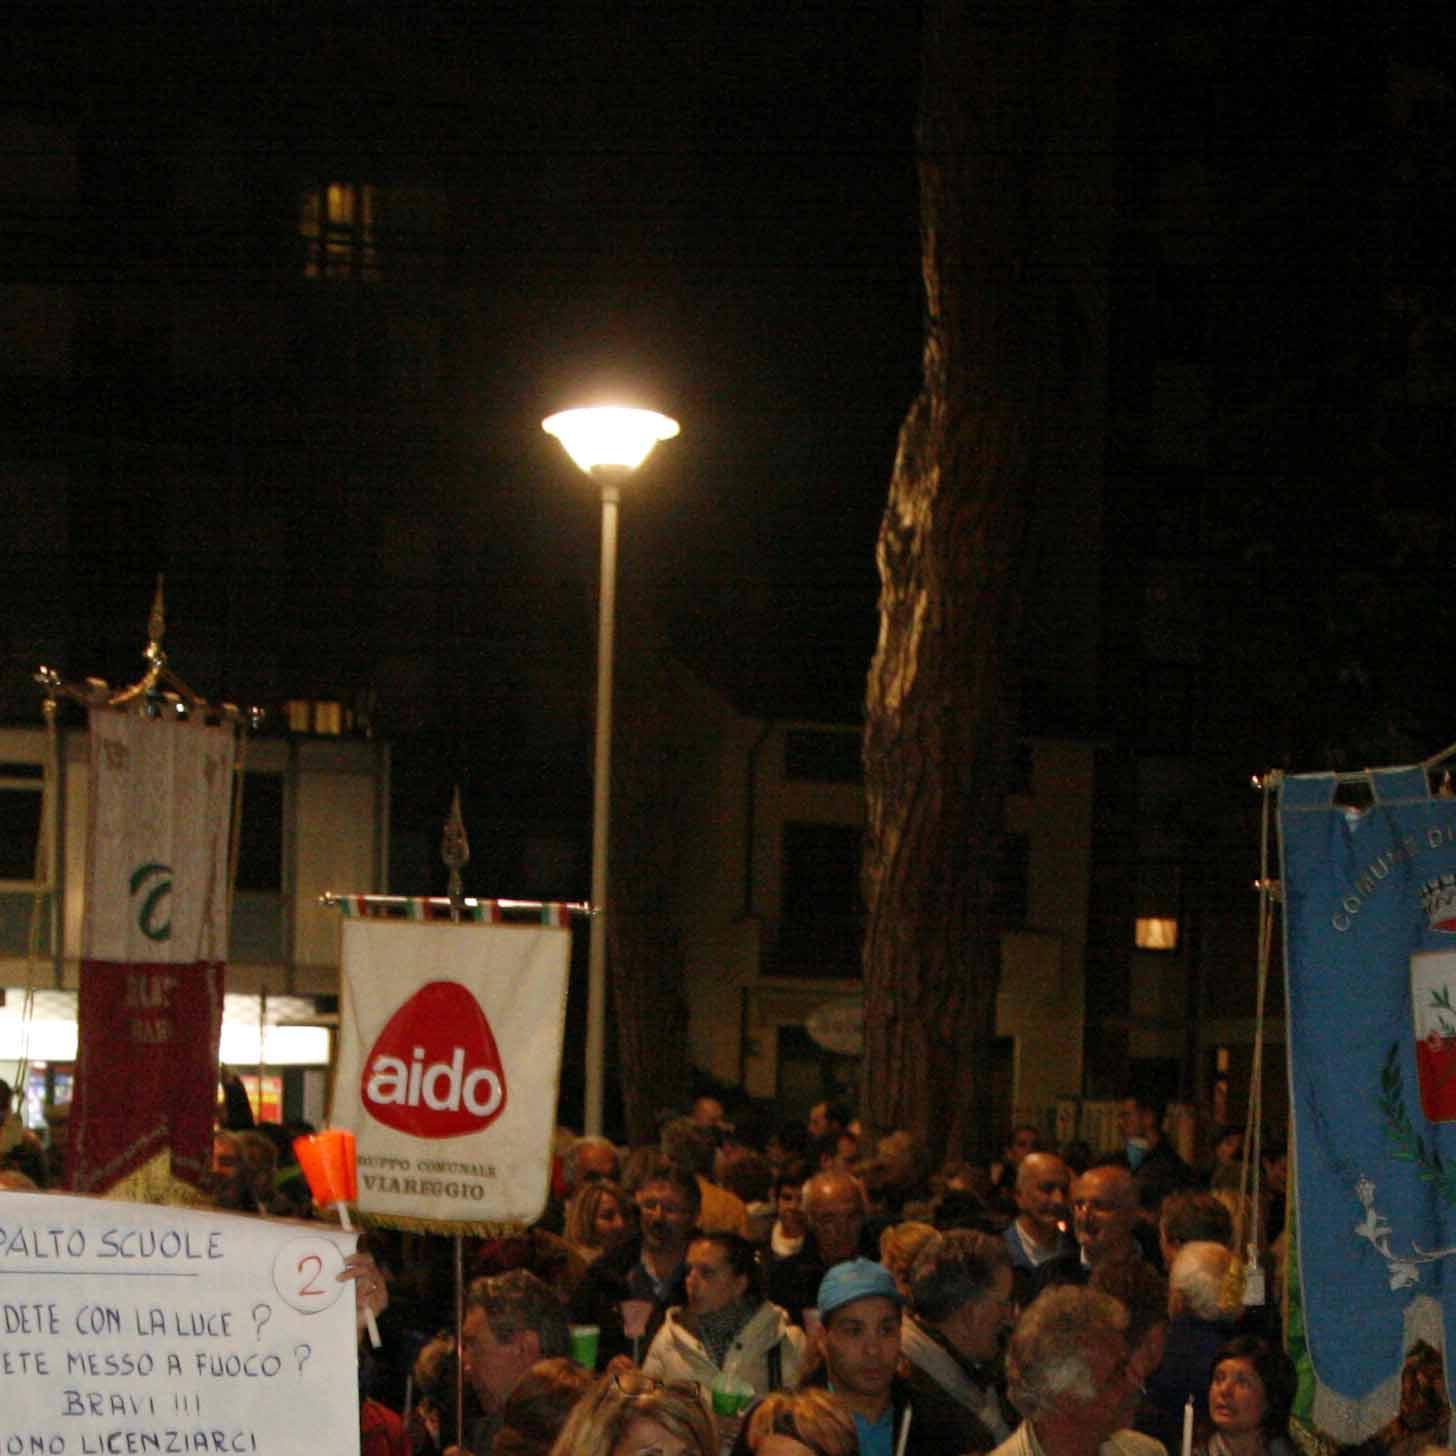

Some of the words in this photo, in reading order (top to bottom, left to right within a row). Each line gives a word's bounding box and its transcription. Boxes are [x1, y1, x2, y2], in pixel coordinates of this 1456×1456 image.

[366, 1046, 503, 1118] aido
[359, 1156, 410, 1171] RUPPO
[364, 1175, 484, 1200] VIAREGGIO
[96, 1229, 225, 1261] SCUOLE
[297, 1255, 326, 1297] 2
[75, 1305, 122, 1336] CON
[135, 1306, 167, 1337] LA
[175, 1309, 234, 1338] LUCE
[66, 1350, 154, 1377] MESSO
[167, 1352, 182, 1376] A
[196, 1350, 282, 1378] FUOCO
[62, 1391, 156, 1417] BRAVI
[81, 1430, 257, 1455] LICENZIARCI
